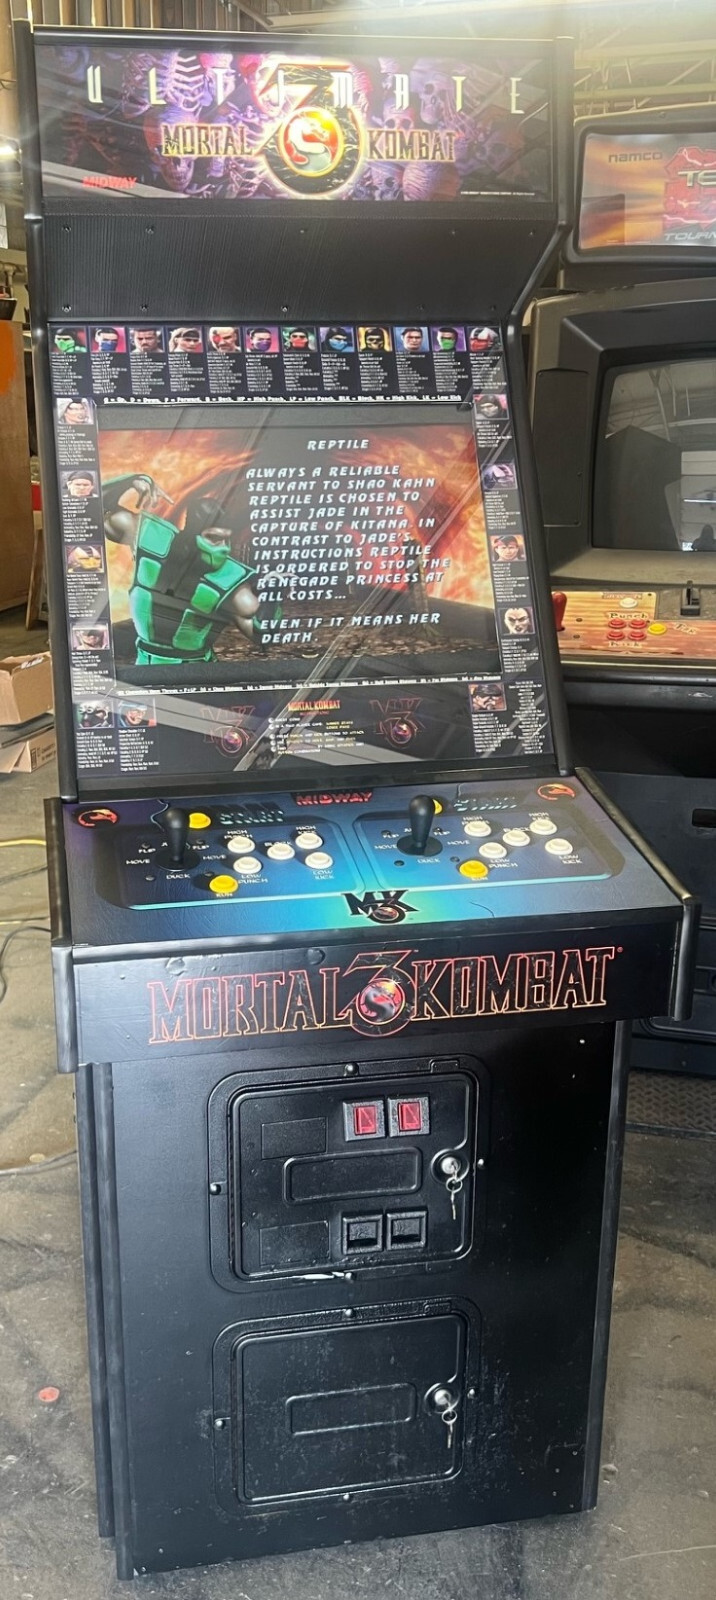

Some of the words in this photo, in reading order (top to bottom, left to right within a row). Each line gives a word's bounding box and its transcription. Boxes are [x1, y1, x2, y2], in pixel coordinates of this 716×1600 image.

[87, 64, 526, 114] ULTIMATE
[161, 124, 254, 156] MORTAL
[366, 129, 458, 162] KOMBAT
[608, 152, 662, 163] namco
[82, 176, 137, 188] MIDWAY
[307, 440, 369, 450] REPTILE
[246, 468, 305, 479] ALWAYS
[312, 467, 322, 477] A
[329, 466, 399, 476] RELIABLE
[248, 481, 316, 492] SERVANT
[323, 480, 340, 490] TO
[347, 479, 386, 490] SHAO
[392, 478, 435, 488] KAHN
[249, 495, 312, 505] REPTILE
[319, 494, 333, 504] IS
[339, 492, 396, 503] CHOSEN
[403, 492, 420, 501] TO
[250, 509, 300, 519] ASSIST
[308, 507, 345, 518] JADE
[353, 507, 370, 516] IN
[376, 506, 404, 516] THE
[250, 522, 318, 533] CAPTURE
[325, 521, 343, 531] OF
[418, 518, 435, 528] IN
[252, 535, 328, 547] CONTRAST
[335, 535, 352, 544] TO
[254, 547, 362, 560] INSTRUCTIONS
[370, 546, 431, 557] REPTILE
[256, 564, 270, 574] IS
[276, 562, 348, 573] ORDERED
[355, 561, 372, 570] TO
[380, 560, 415, 570] STOP
[421, 558, 450, 568] THE
[257, 577, 338, 589] RENEGADE
[346, 573, 419, 584] PRINCESS
[425, 572, 444, 582] AT
[258, 592, 283, 602] ALL
[260, 619, 300, 630] EVEN
[307, 618, 322, 628] IF
[330, 617, 344, 627] IT
[351, 615, 403, 626] MEANS
[409, 613, 441, 623] HER
[261, 632, 318, 643] DEATH.
[296, 792, 372, 806] MIDWAY
[146, 968, 351, 1044] MORTAL
[410, 946, 616, 1022] KOMBAT
